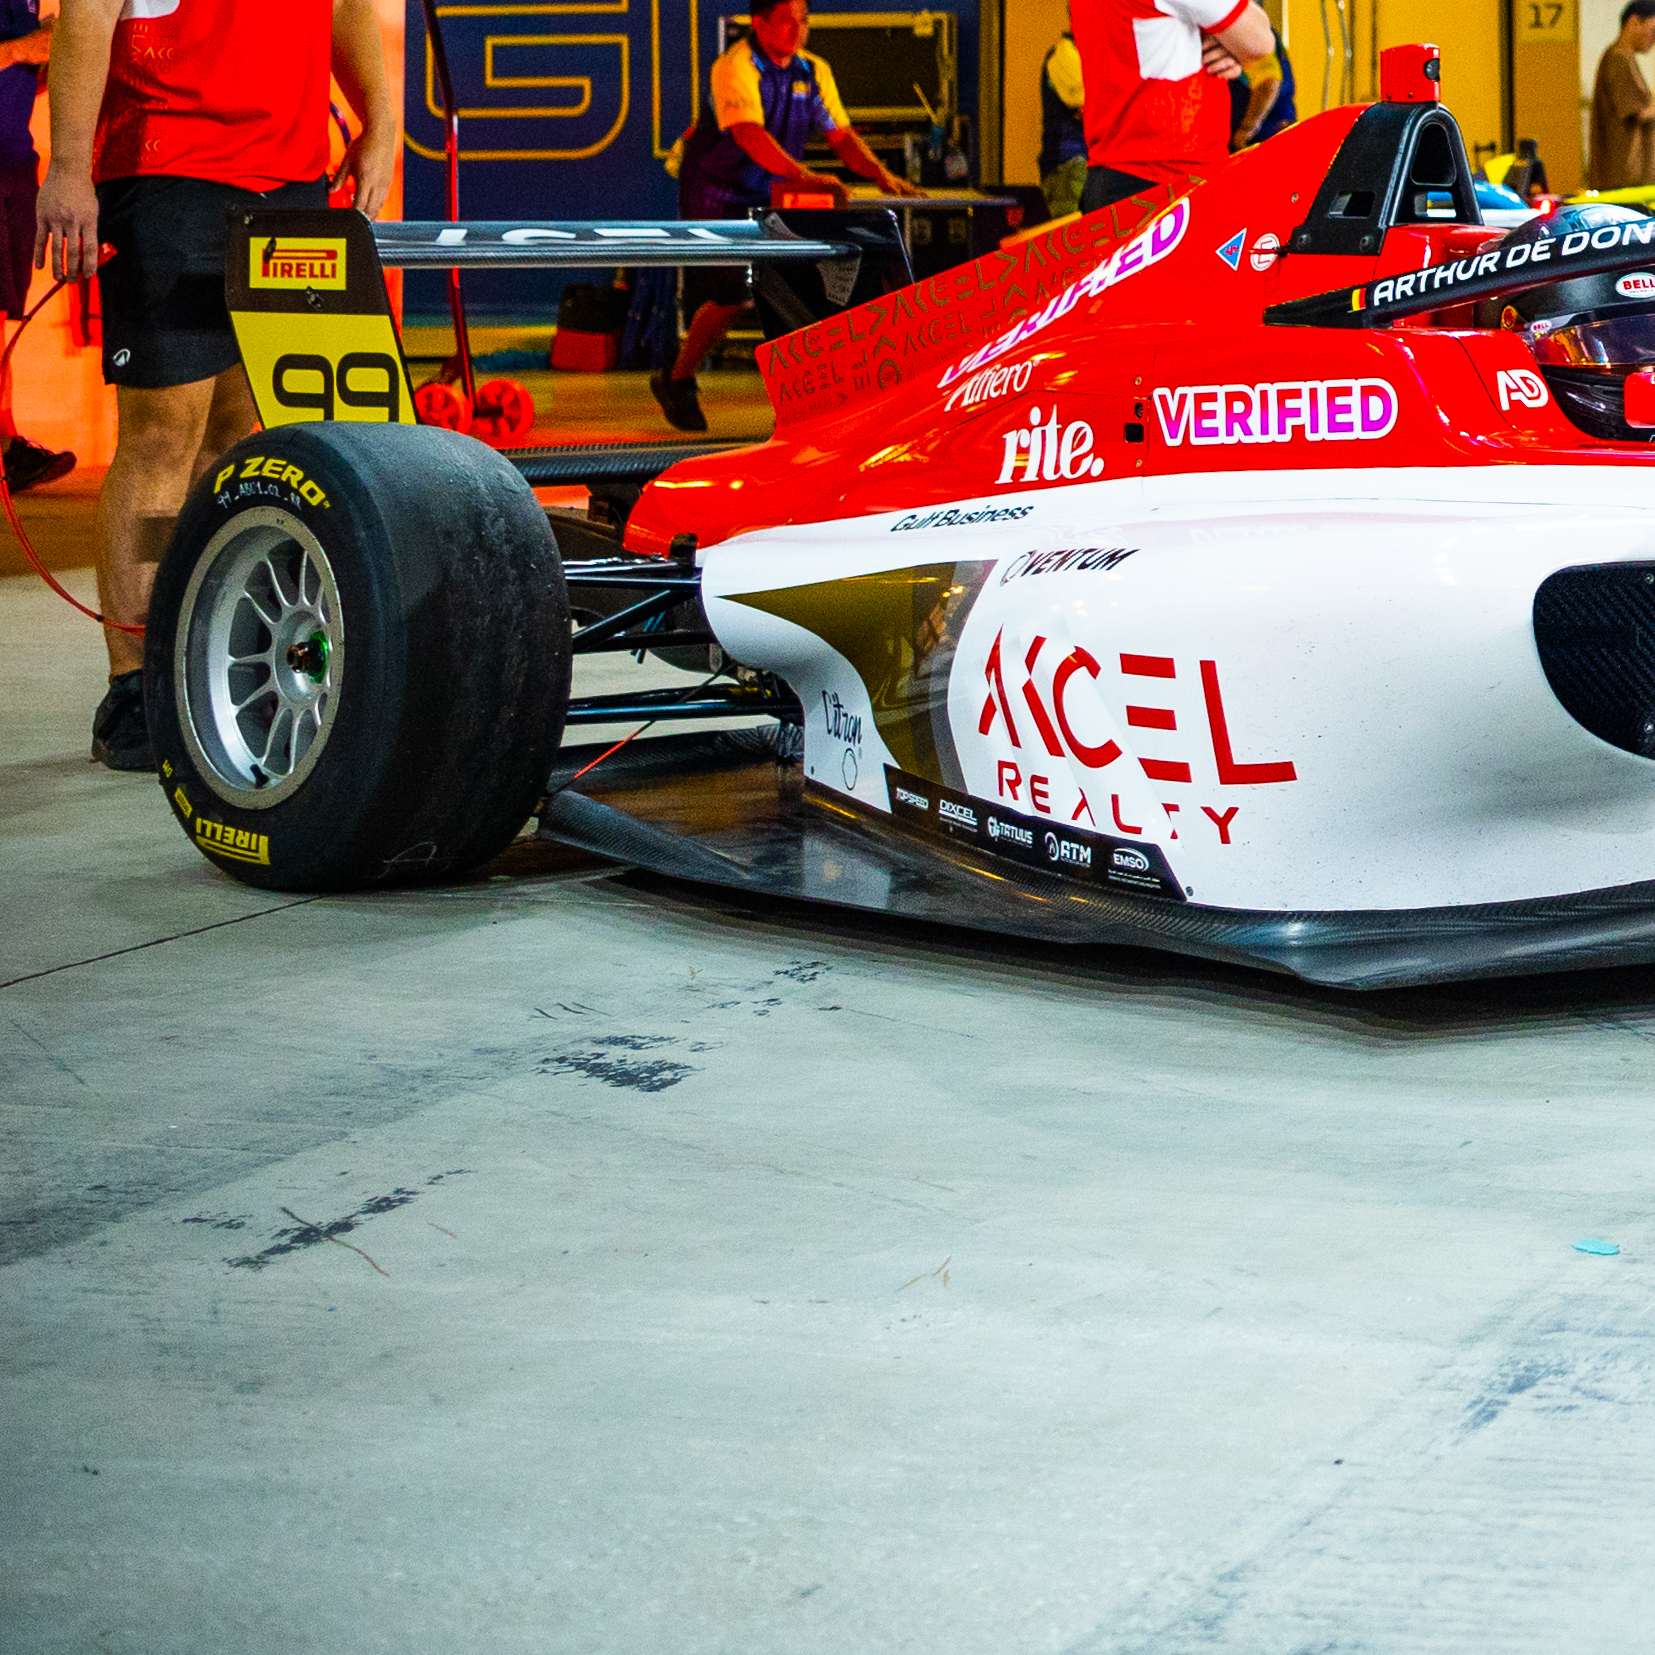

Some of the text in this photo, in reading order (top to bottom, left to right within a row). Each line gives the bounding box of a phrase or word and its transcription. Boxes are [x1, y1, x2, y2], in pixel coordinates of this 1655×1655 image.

[1526, 3, 1563, 29] 17
[261, 247, 338, 280] PIRELLI
[1373, 250, 1500, 306] ARTHUR
[1506, 236, 1555, 268] DE
[273, 351, 400, 423] 99
[1151, 377, 1398, 447] VERIFIED
[995, 403, 1105, 486] rite.
[213, 456, 327, 507] P ZERO
[890, 505, 1035, 532] Gulf Business
[938, 799, 978, 821] DIXCEL
[998, 759, 1239, 845] REALTY
[196, 817, 271, 865] PIRELLI
[1060, 840, 1092, 864] ATM
[1112, 852, 1145, 870] EMSO
